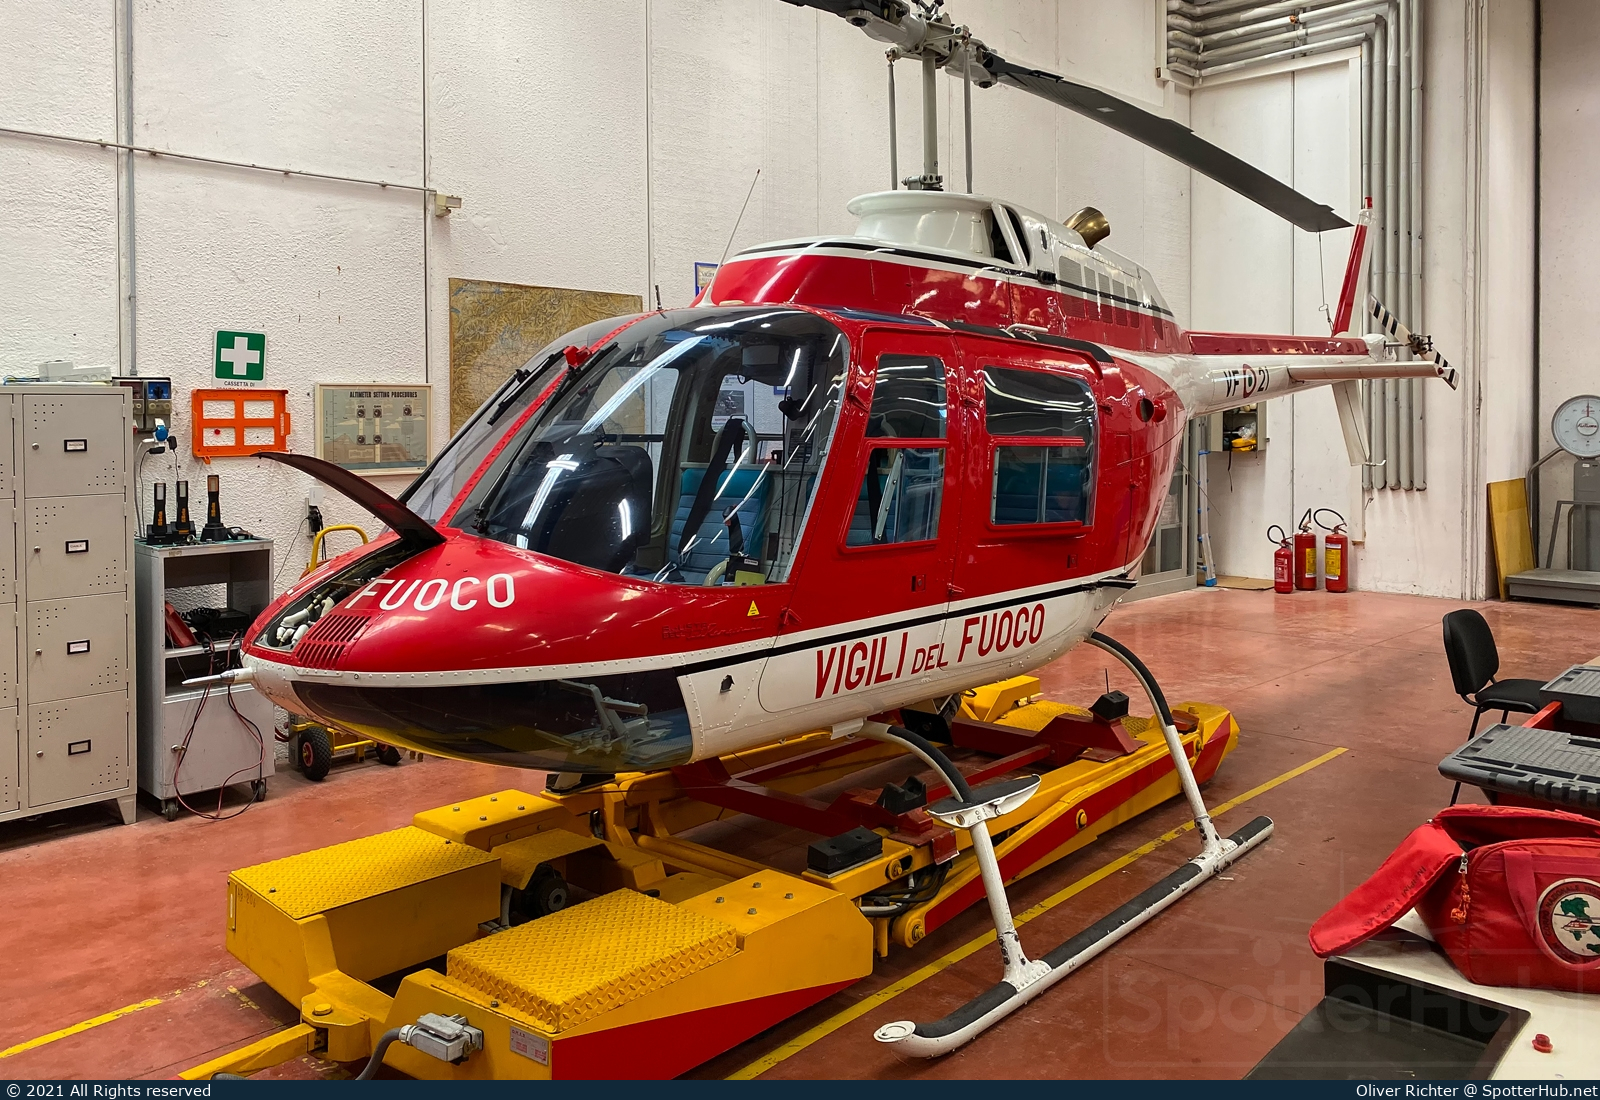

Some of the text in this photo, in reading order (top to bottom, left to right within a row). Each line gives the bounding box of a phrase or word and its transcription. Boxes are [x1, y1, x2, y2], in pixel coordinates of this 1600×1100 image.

[1223, 366, 1270, 397] VF 21
[345, 573, 515, 611] FUOCO
[815, 603, 1046, 699] VIGILI DEL FUOCO
